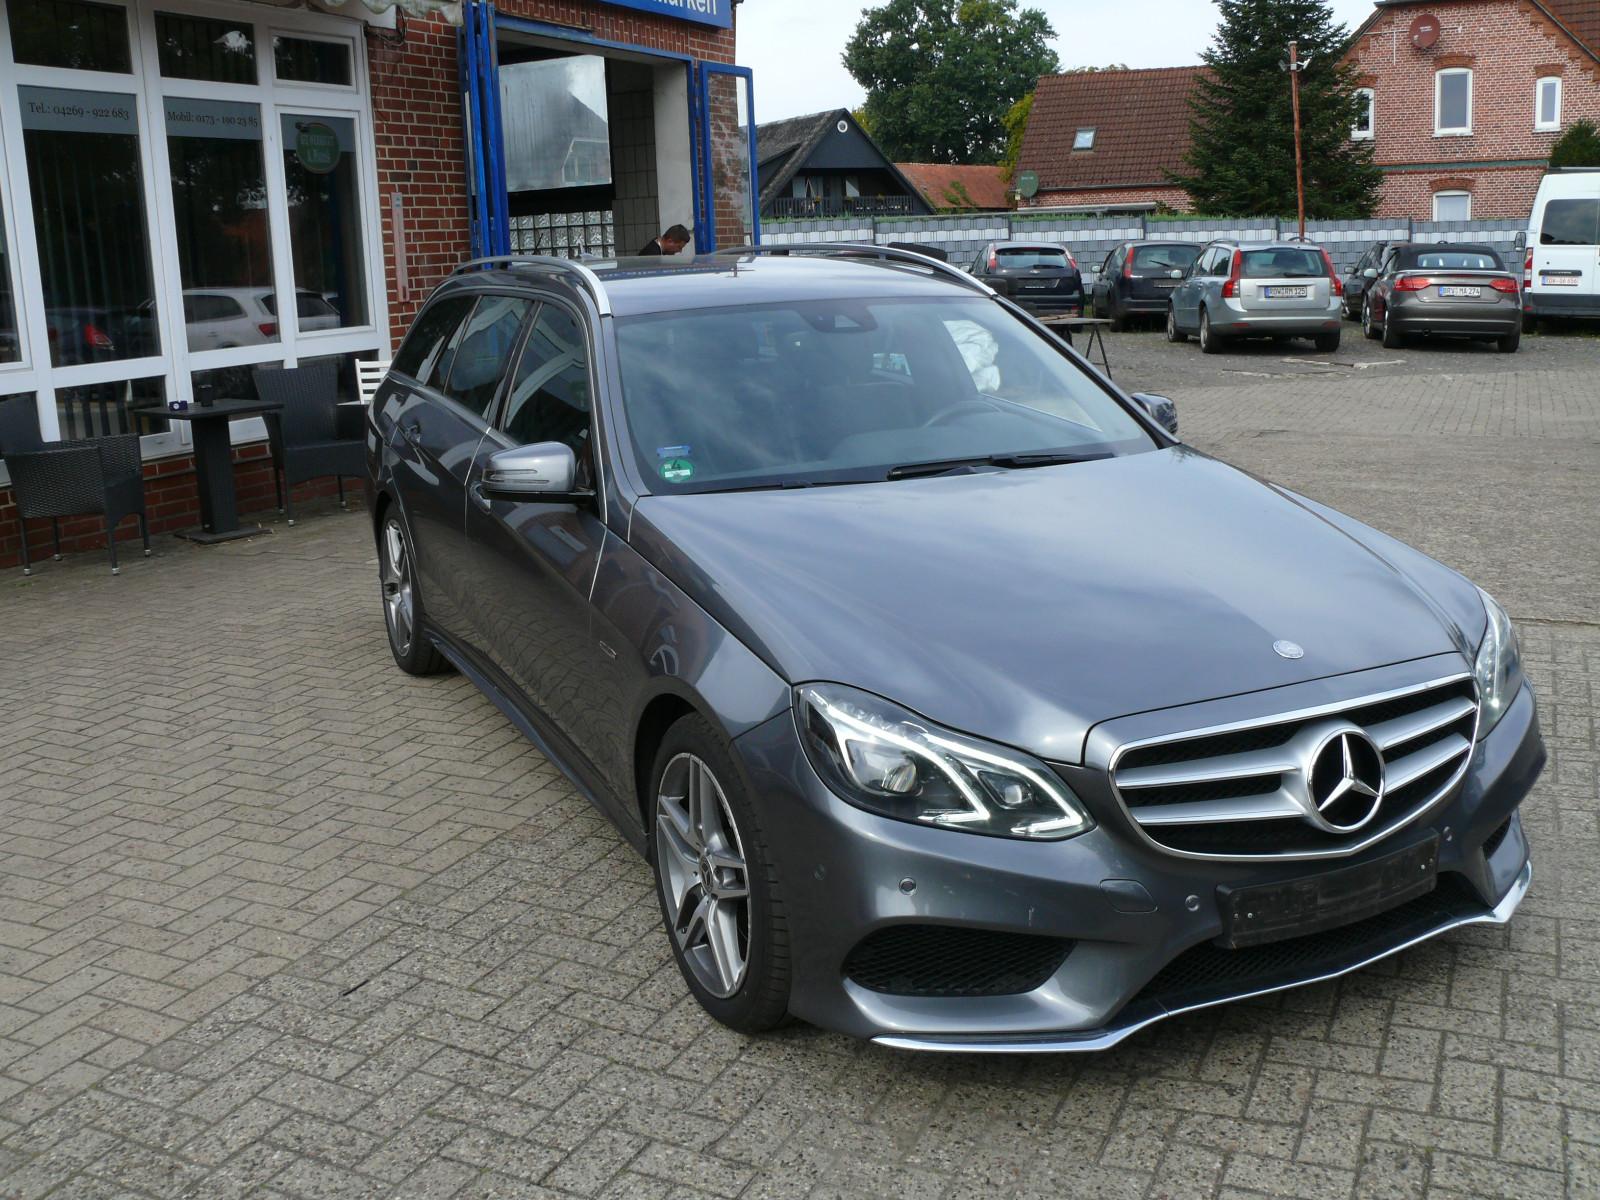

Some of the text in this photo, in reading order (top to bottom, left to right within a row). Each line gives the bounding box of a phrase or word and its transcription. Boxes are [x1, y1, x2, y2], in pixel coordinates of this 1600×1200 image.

[53, 105, 84, 118] 04269
[91, 107, 111, 118] 922
[111, 106, 130, 121] 683
[167, 111, 194, 122] Mobil:
[671, 459, 682, 470] 4
